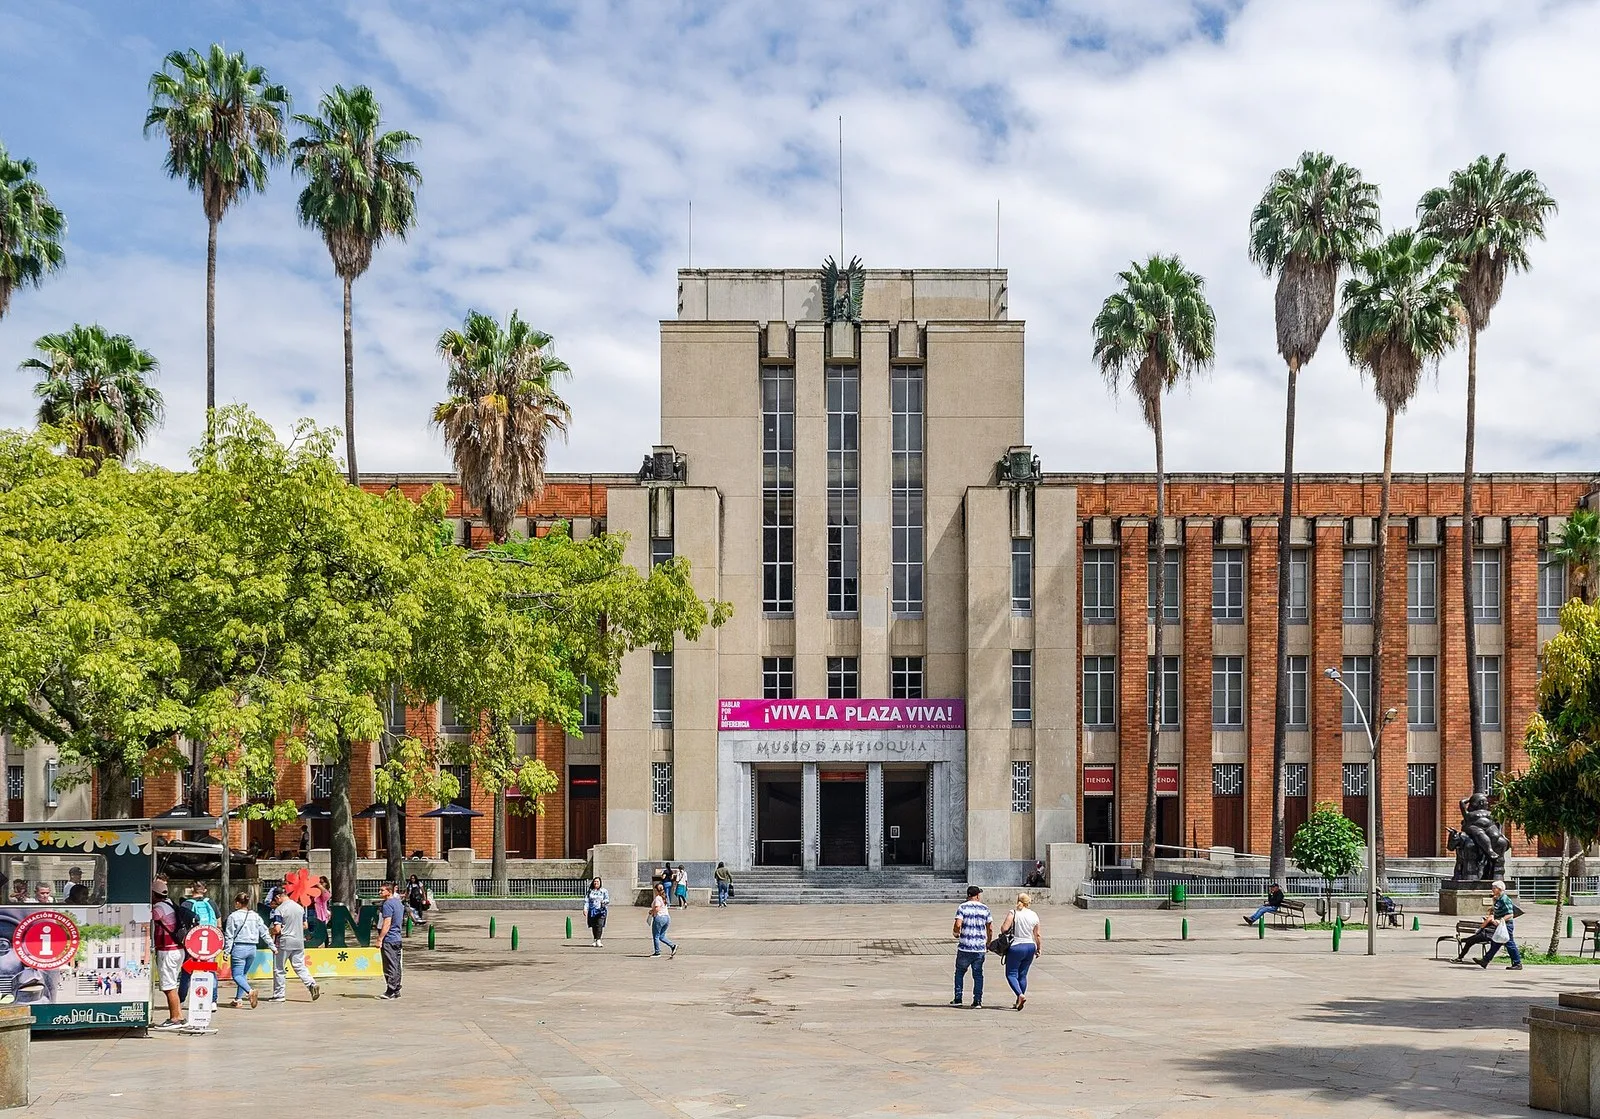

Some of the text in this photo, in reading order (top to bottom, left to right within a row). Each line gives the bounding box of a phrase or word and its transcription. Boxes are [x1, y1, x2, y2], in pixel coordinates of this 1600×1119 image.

[764, 705, 953, 723] ¡VIVA LA PLAZA VIVA!
[756, 741, 811, 755] MUSEO
[831, 740, 928, 755] ANTIOQUIA
[15, 912, 78, 939] INFORMACIÓN TURÍSTICA
[16, 946, 76, 968] TOURIST INFORMATION
